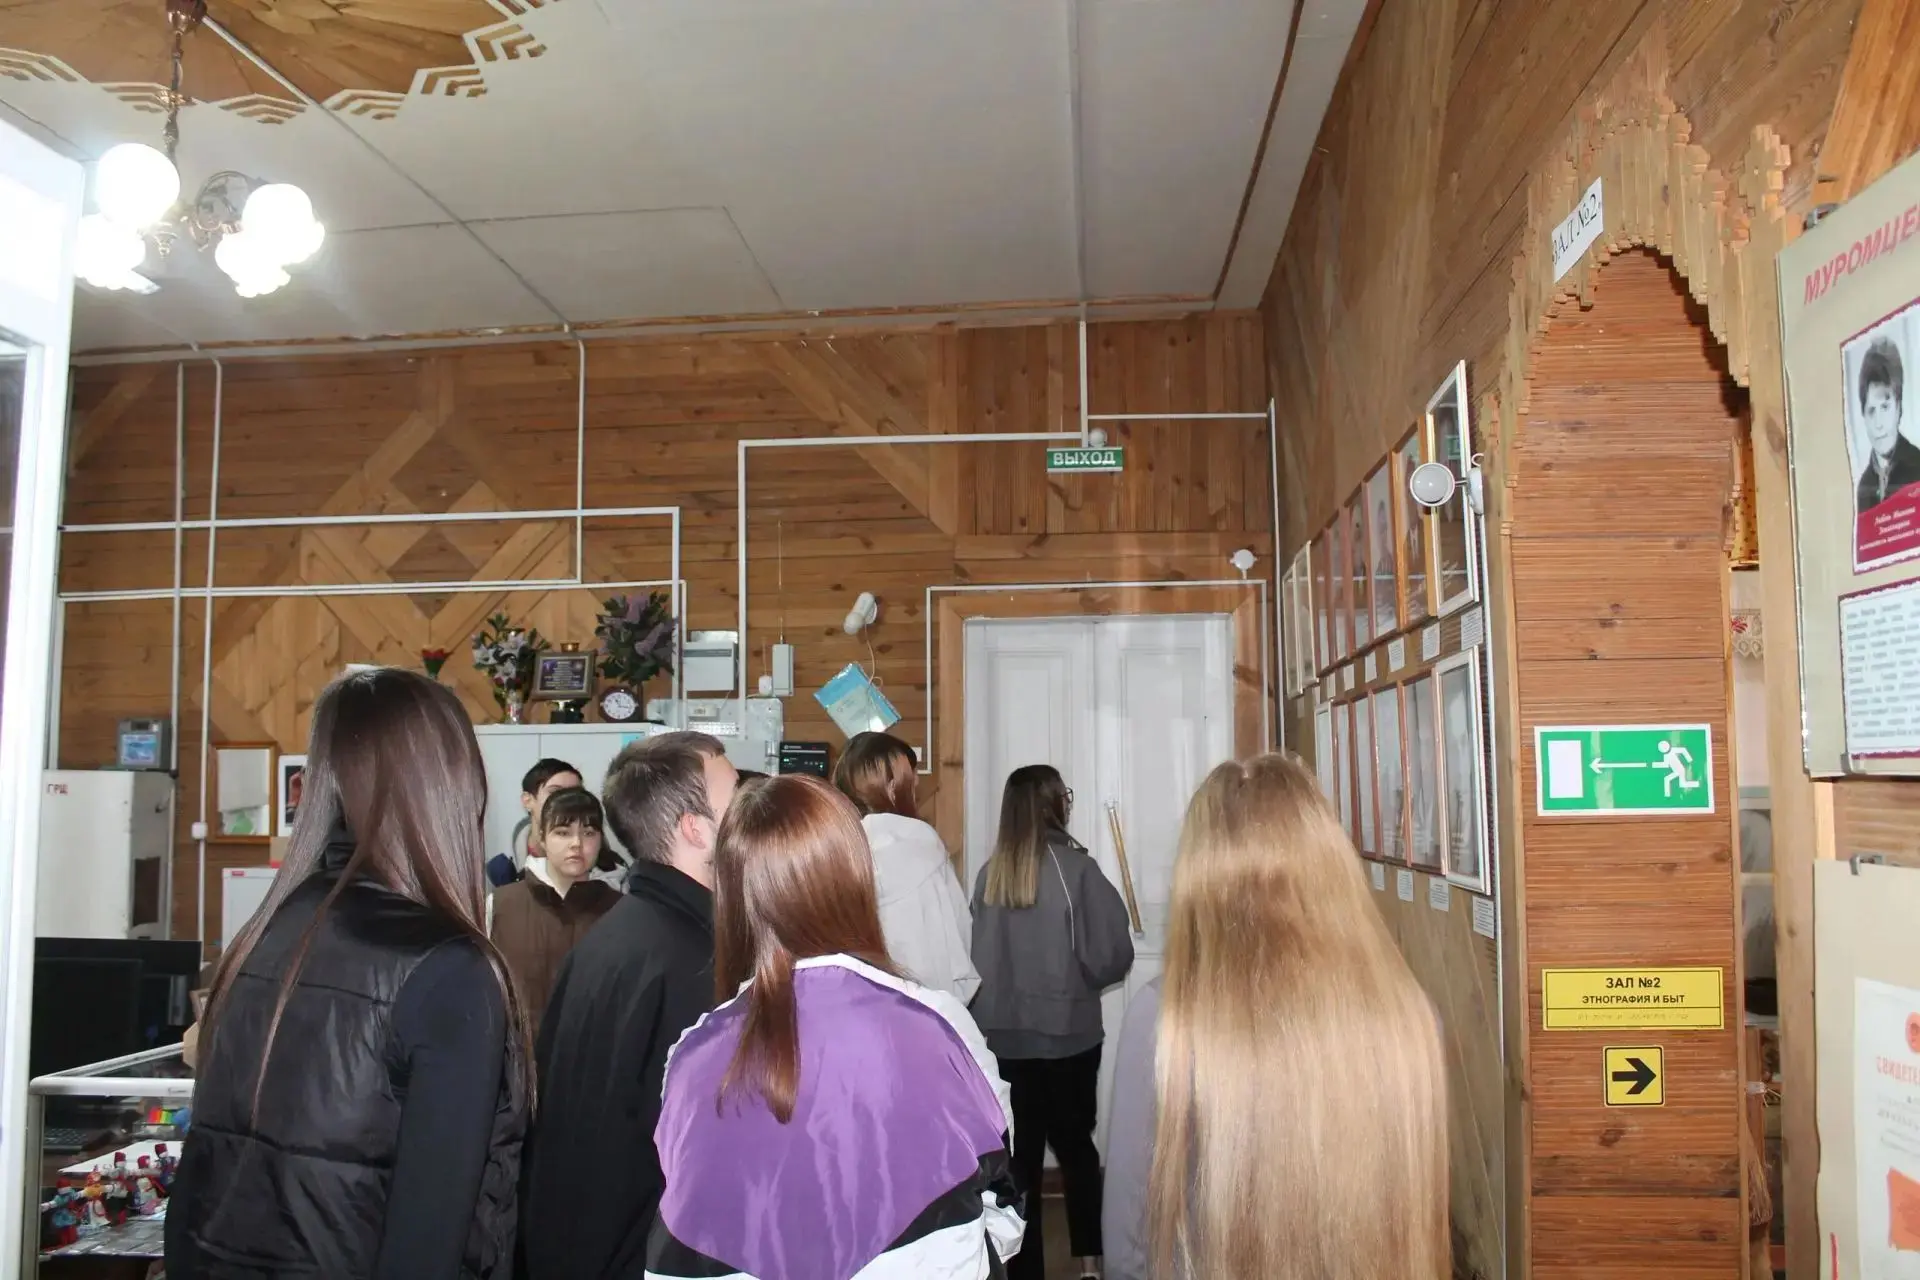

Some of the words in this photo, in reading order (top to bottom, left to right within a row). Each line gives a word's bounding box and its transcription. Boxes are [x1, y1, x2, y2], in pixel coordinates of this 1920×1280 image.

[1552, 219, 1574, 265] ЗАЛ
[1804, 200, 1920, 305] МУРОМЦЕ
[1053, 451, 1116, 466] ВЫХОД
[1606, 977, 1634, 988] ЗАЛ
[1638, 977, 1661, 988] №2
[1582, 996, 1650, 1004] ЭТНОГРАФИЯ
[1662, 995, 1685, 1003] БЫТ
